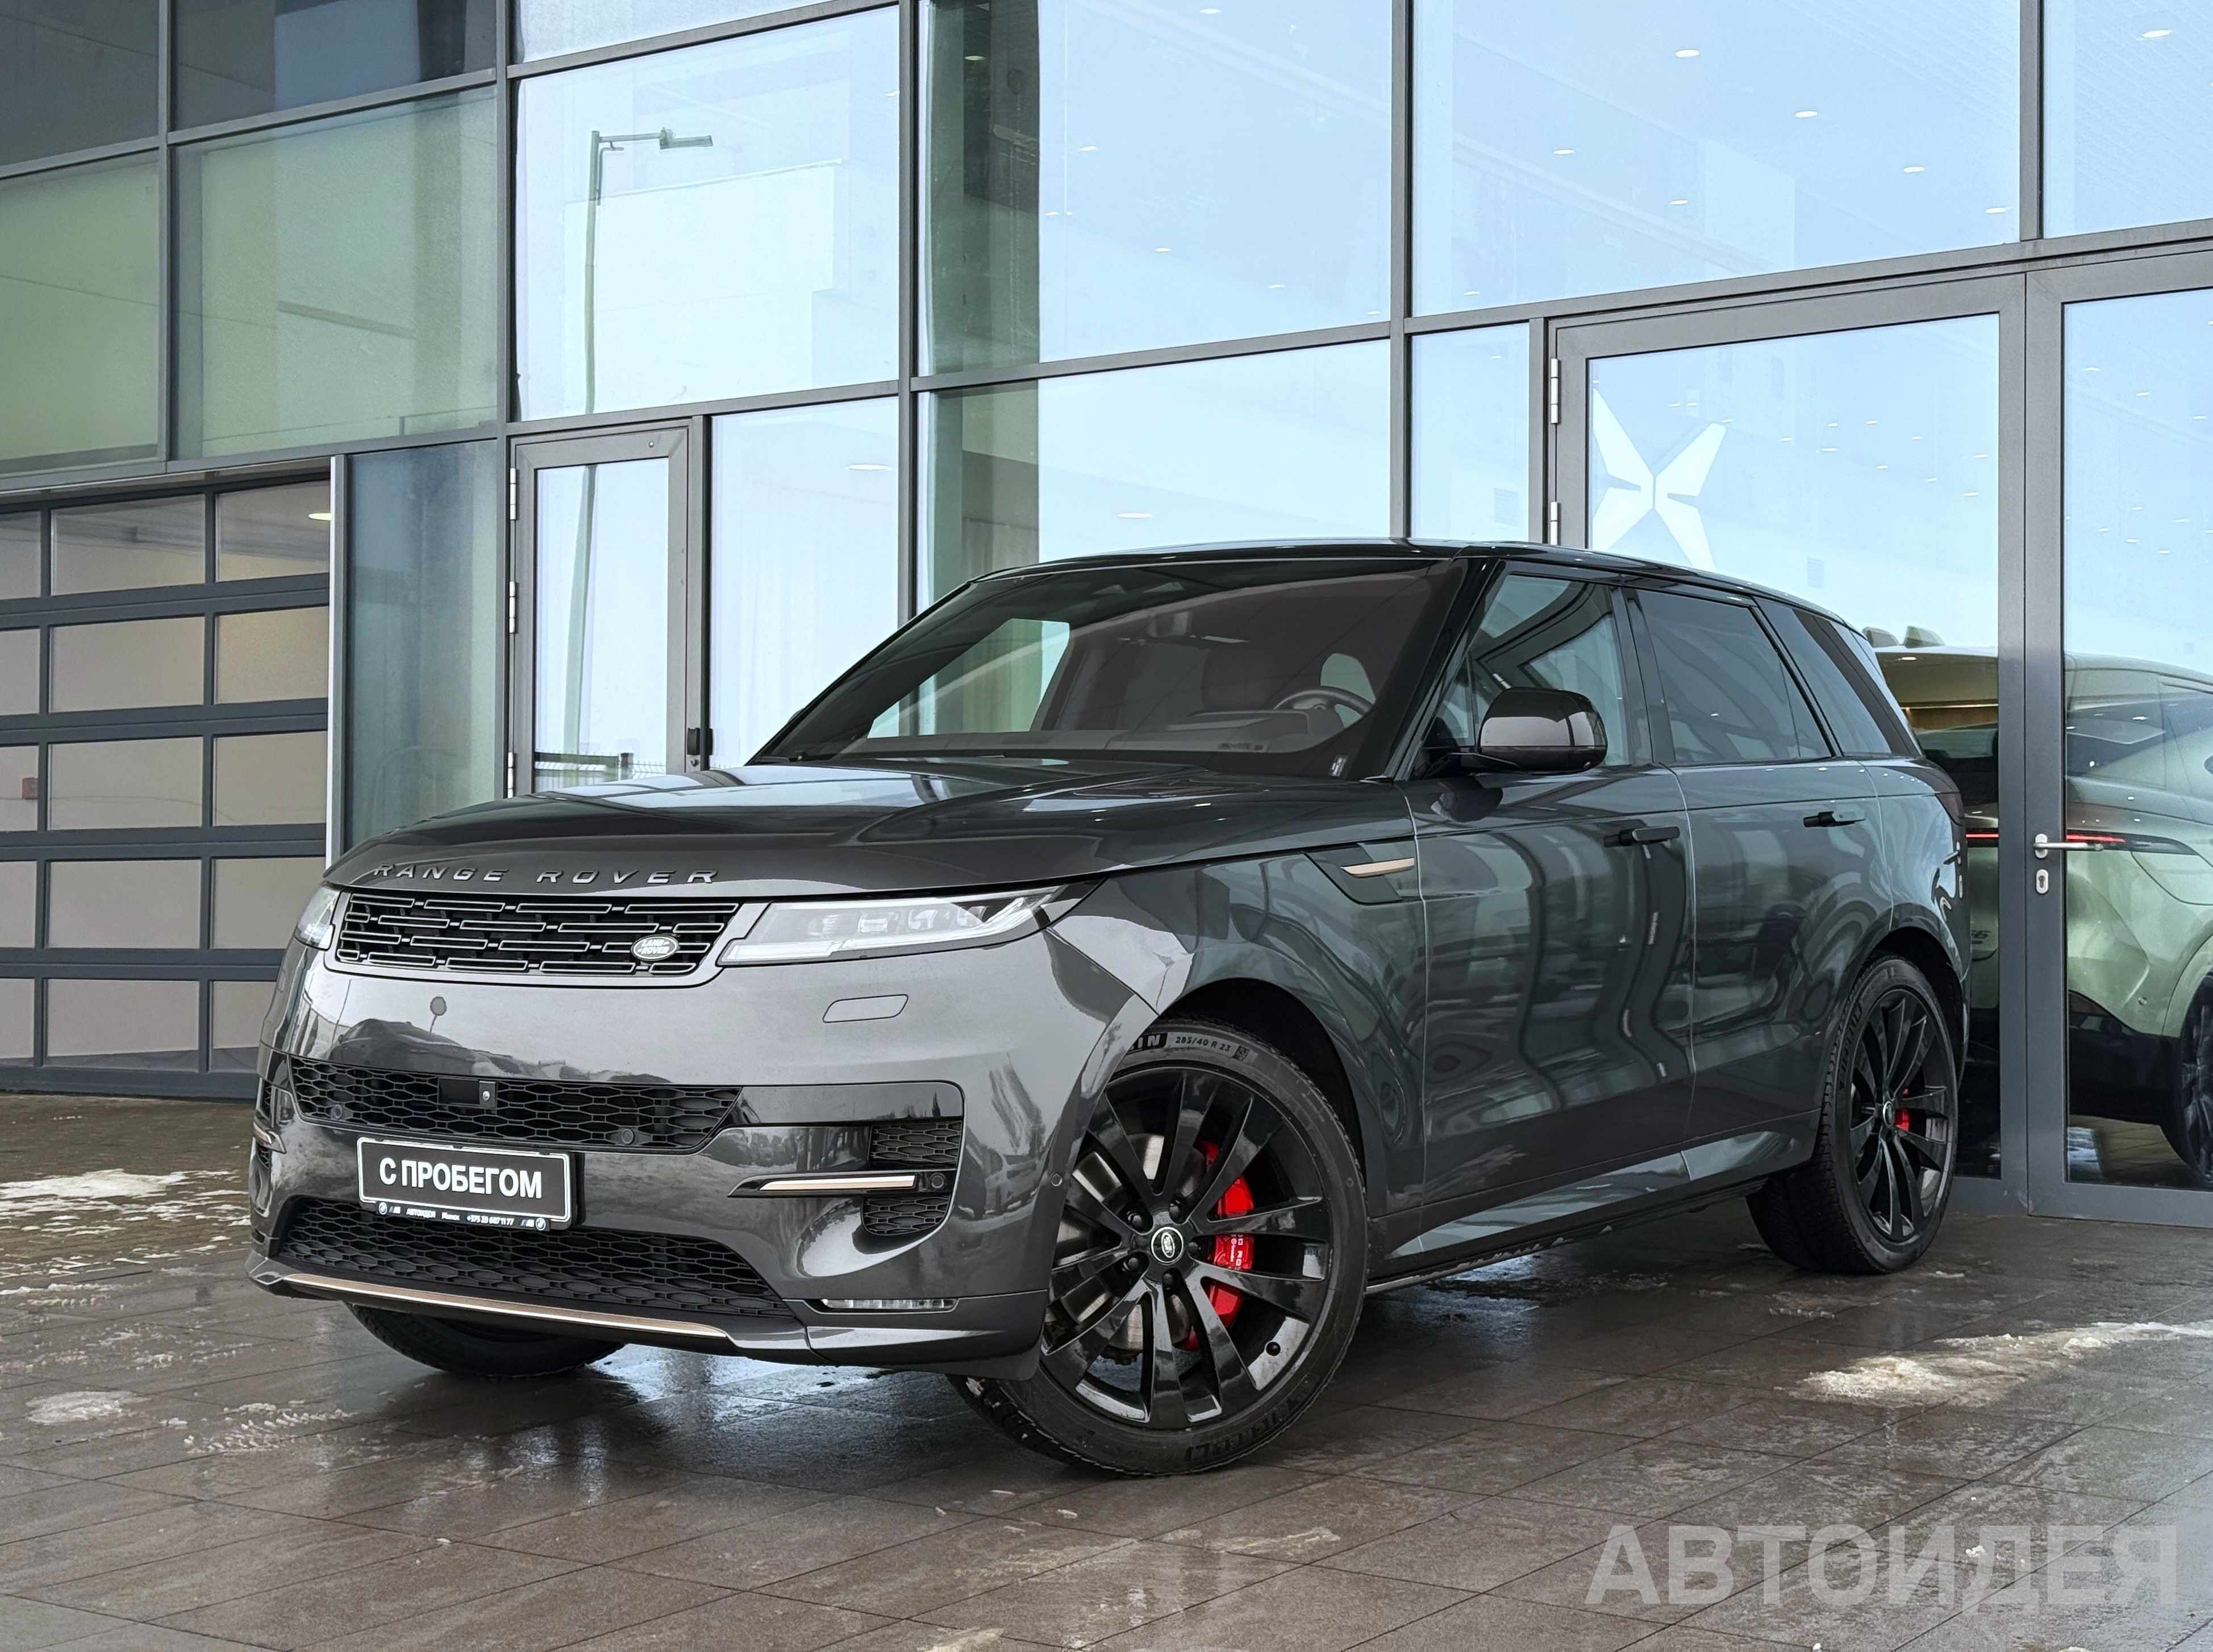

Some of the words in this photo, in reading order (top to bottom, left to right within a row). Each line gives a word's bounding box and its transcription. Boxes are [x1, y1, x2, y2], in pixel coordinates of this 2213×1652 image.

[373, 863, 509, 881] RANGE
[536, 870, 718, 884] ROVER
[1219, 1043, 1232, 1052] 23
[379, 1157, 397, 1185] С
[401, 1159, 541, 1199] ПРОБЕГОМ
